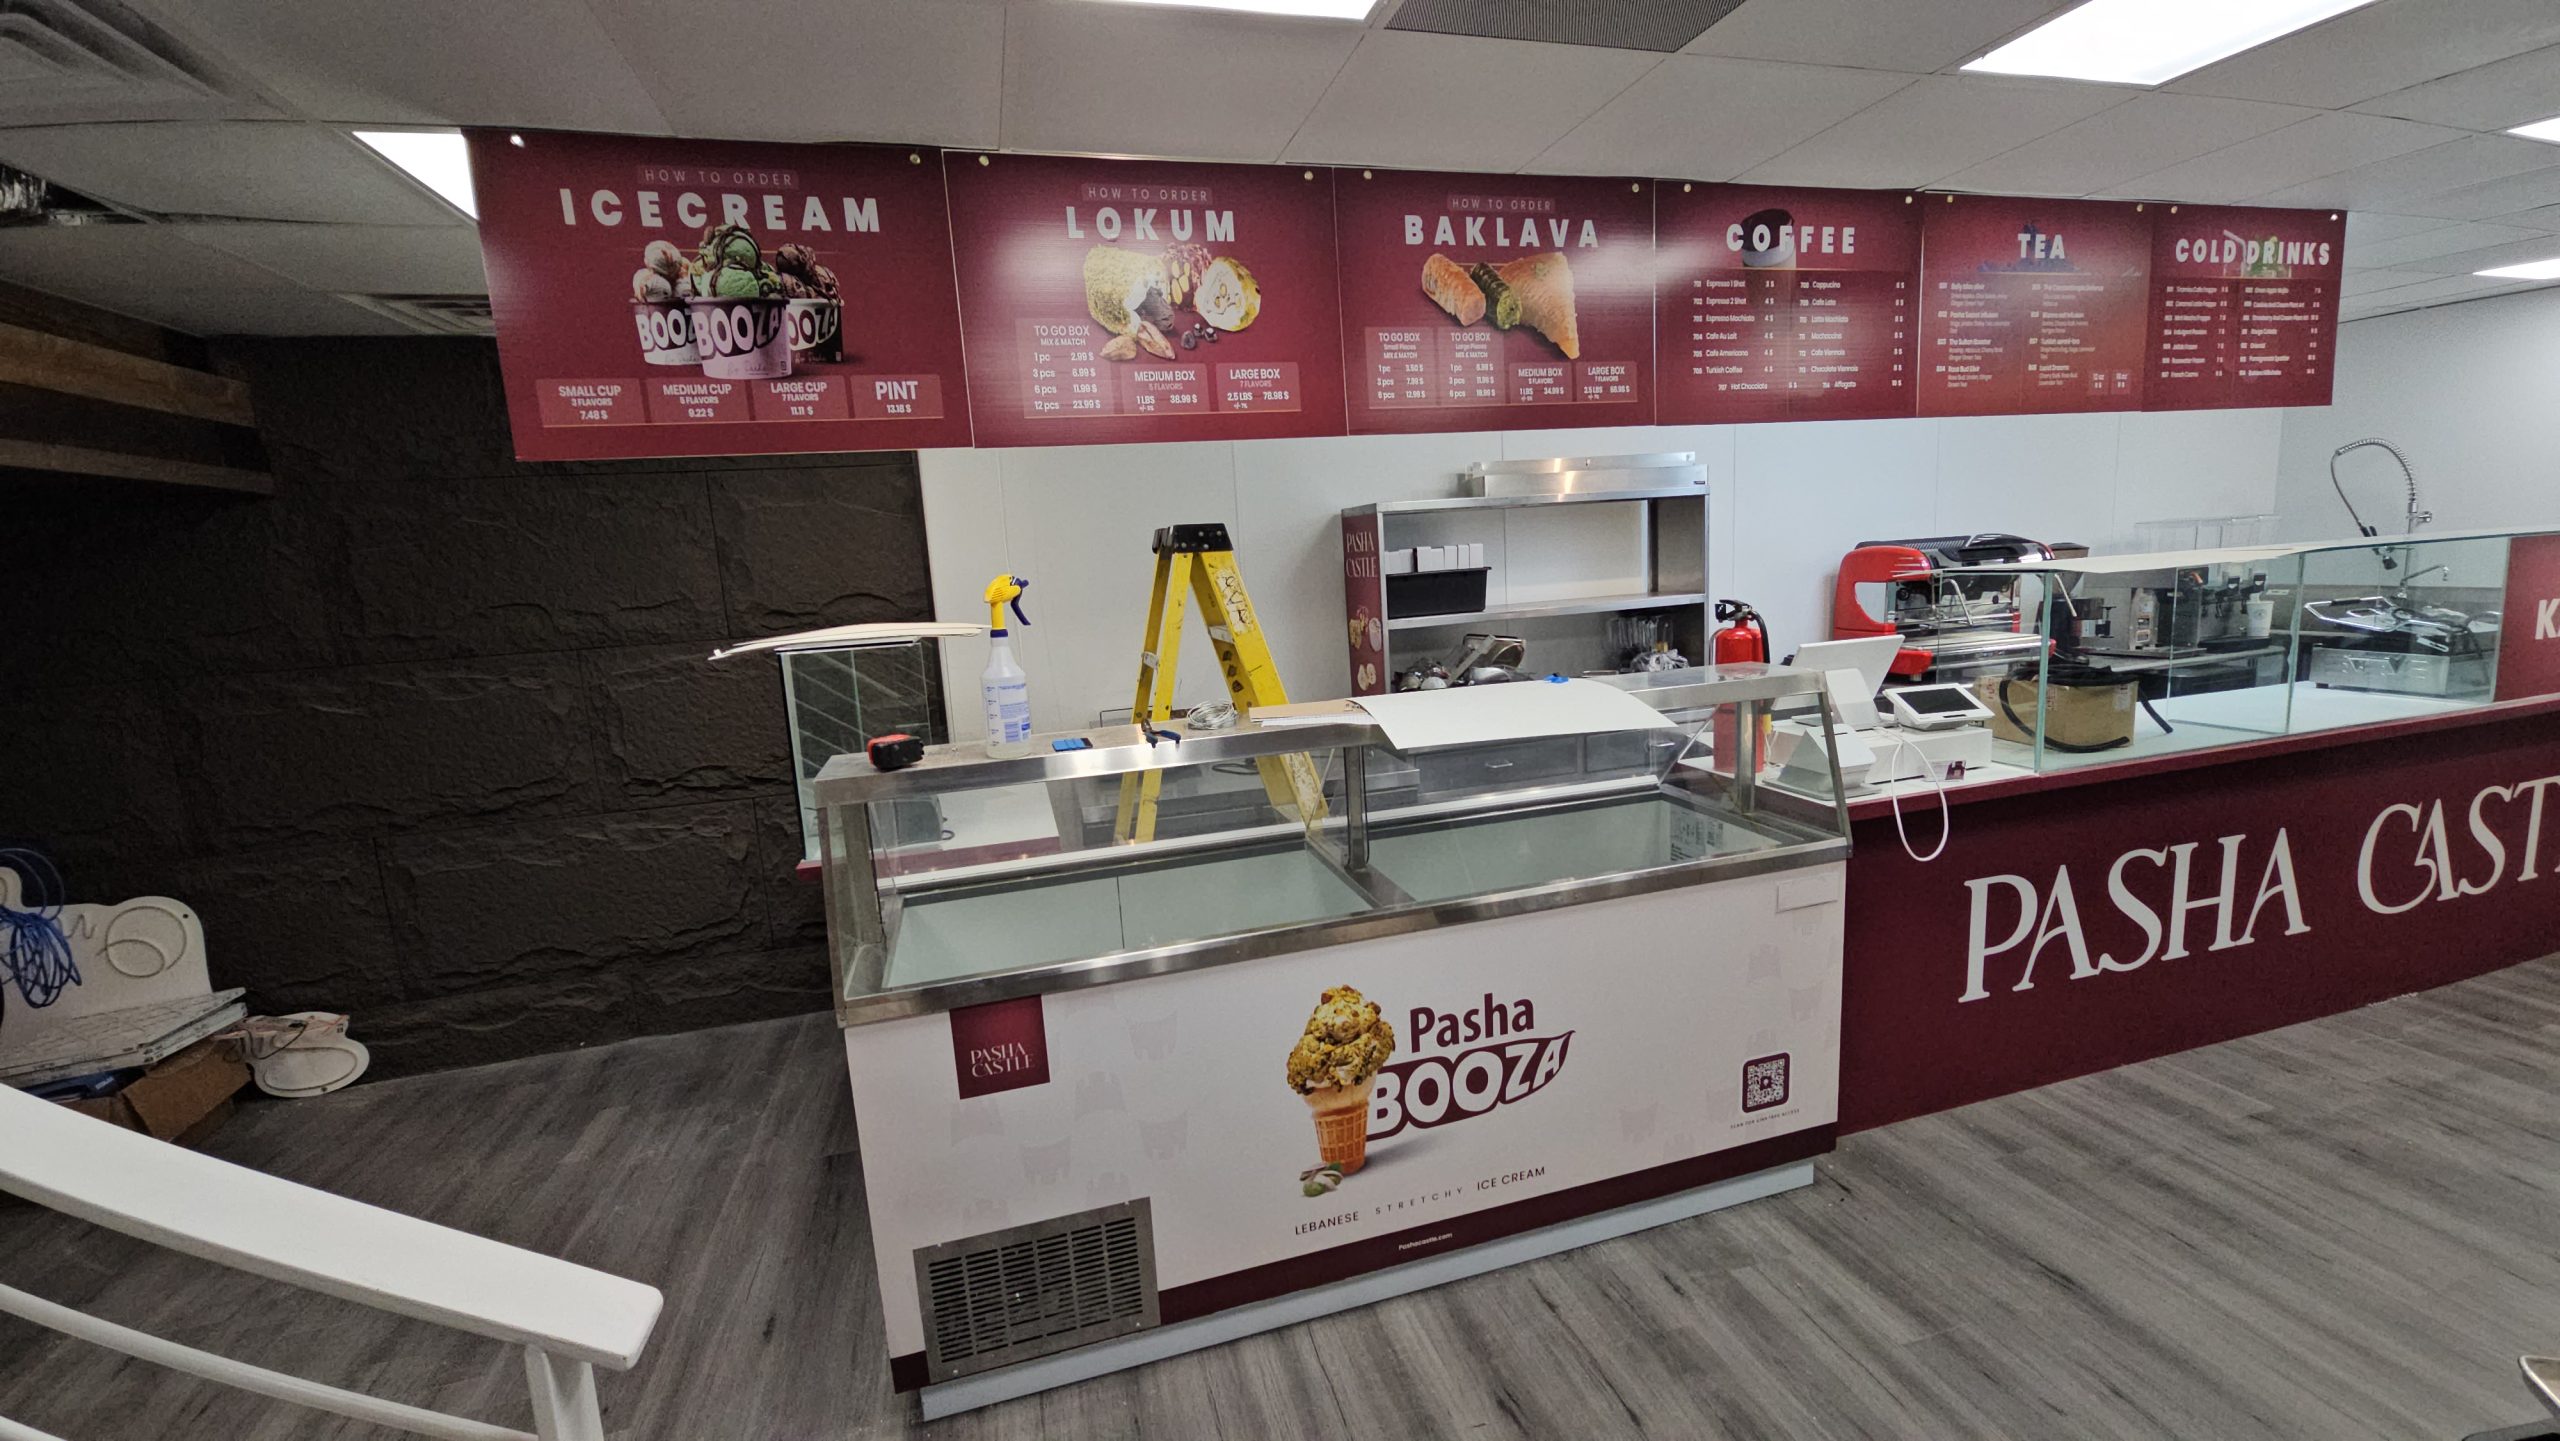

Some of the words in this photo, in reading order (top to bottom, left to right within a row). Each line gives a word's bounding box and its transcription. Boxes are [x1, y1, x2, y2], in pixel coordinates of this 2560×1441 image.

[645, 169, 686, 182] HOW
[700, 171, 720, 183] TO
[733, 172, 792, 186] ORDER
[1088, 188, 1121, 199] HOW
[1132, 189, 1150, 199] TO
[1160, 190, 1208, 201] ORDER
[560, 189, 880, 232] ICECREAM
[1452, 199, 1480, 209] HOW
[1488, 199, 1503, 209] TO
[1511, 200, 1551, 211] ORDER
[1066, 206, 1235, 242] LOKUM
[1404, 215, 1599, 248] BAKLAVA
[1726, 224, 1855, 253] COFFEE
[2018, 234, 2065, 259] TEA
[2176, 239, 2236, 263] COLD
[2247, 240, 2329, 265] DRINKS
[691, 305, 782, 357] BOOZA
[1034, 326, 1048, 336] TO
[1051, 326, 1066, 336] GO
[1069, 326, 1090, 336] BOX
[1379, 333, 1388, 341] TO
[1391, 333, 1402, 341] GO
[1405, 333, 1420, 341] BOX
[1451, 333, 1460, 341] TO
[1462, 333, 1473, 341] GO
[1475, 333, 1491, 341] BOX
[1135, 371, 1173, 381] MEDIUM
[1175, 370, 1195, 380] BOX
[1230, 370, 1259, 379] LARGE
[1261, 369, 1280, 379] BOX
[1518, 368, 1546, 376] MEDIUM
[1548, 368, 1562, 376] BOX
[1588, 367, 1609, 375] LARGE
[1611, 367, 1624, 375] BOX
[559, 386, 595, 396] SMALL
[597, 385, 621, 396] CUP
[663, 384, 708, 395] MEDIUM
[709, 384, 732, 394] CUP
[771, 382, 804, 393] LARGE
[805, 382, 827, 392] CUP
[875, 381, 918, 400] PINT
[578, 398, 612, 406] FLAVORS
[686, 396, 719, 404] FLAVORS
[1035, 401, 1044, 409] 12
[1958, 828, 2311, 1003] PASHA
[2357, 775, 2560, 914] CAST
[1410, 993, 1534, 1053] Pasha
[971, 1042, 1025, 1064] PASHA
[972, 1054, 1035, 1077] CASTLE
[1366, 1036, 1571, 1135] BOOZA
[1295, 1211, 1359, 1235] LEBANESE
[1376, 1187, 1463, 1215] STRETCHY
[1477, 1178, 1497, 1191] ICE
[1501, 1166, 1545, 1185] CREAM
